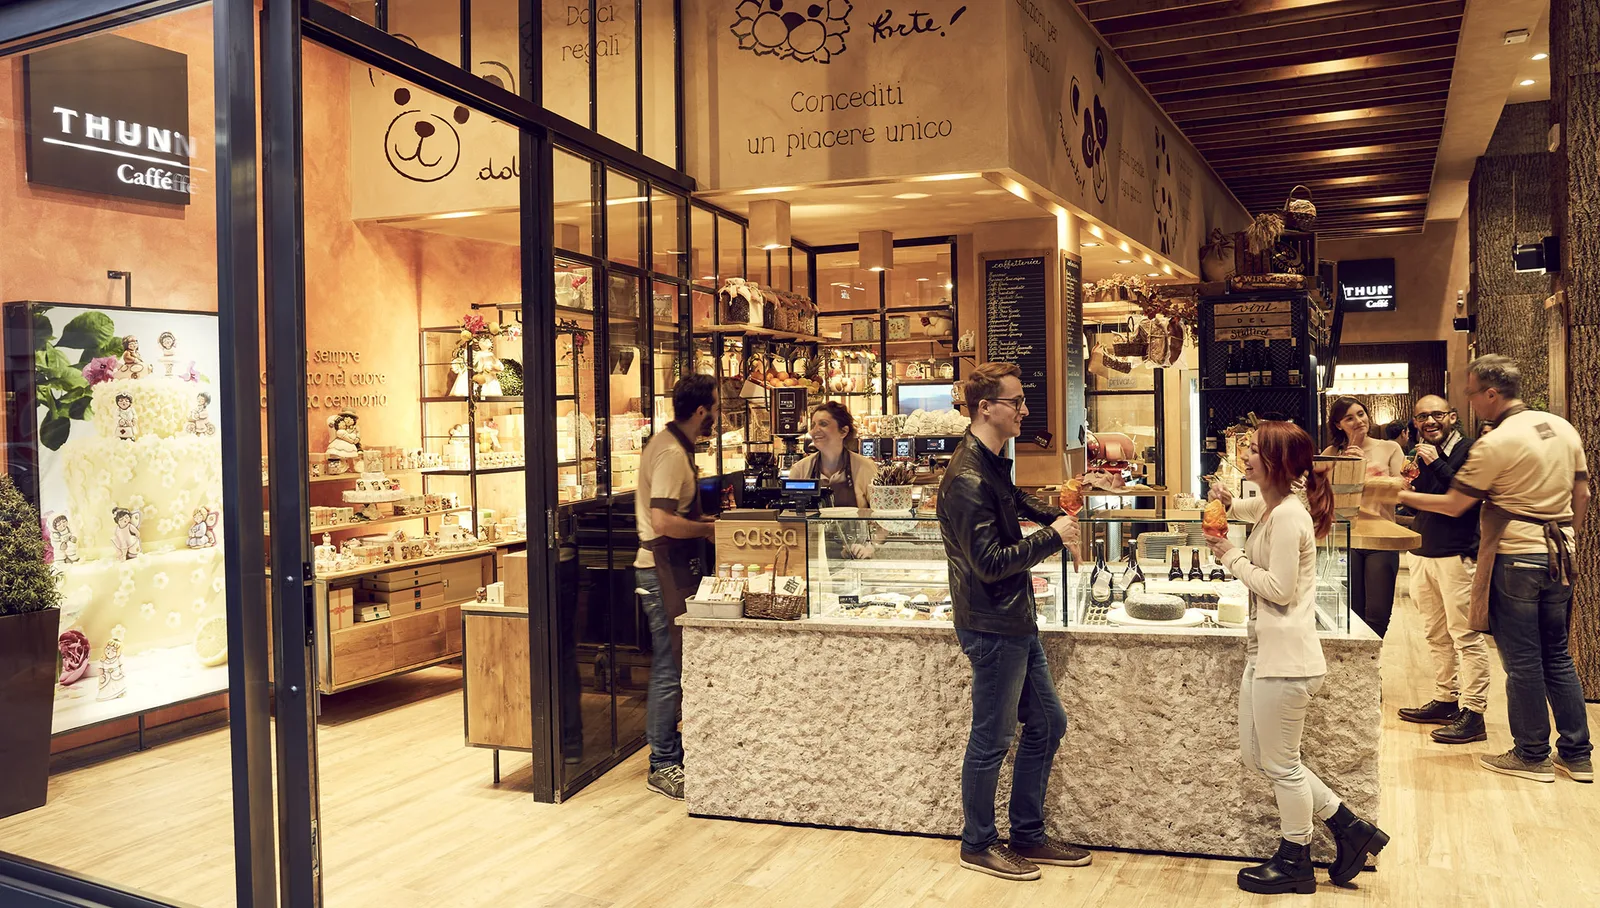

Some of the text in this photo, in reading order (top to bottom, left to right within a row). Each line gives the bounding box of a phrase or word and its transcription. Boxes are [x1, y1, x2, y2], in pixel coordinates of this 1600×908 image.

[566, 5, 615, 26] Doci
[790, 80, 904, 113] Concediti
[53, 105, 172, 154] THUN
[747, 115, 953, 158] un piacere unico
[475, 155, 520, 181] dol
[1345, 284, 1389, 297] THUN
[1232, 302, 1277, 313] vini
[313, 350, 361, 368] sempre
[325, 370, 347, 387] nel
[350, 372, 387, 386] cuore
[731, 526, 799, 548] cassa
